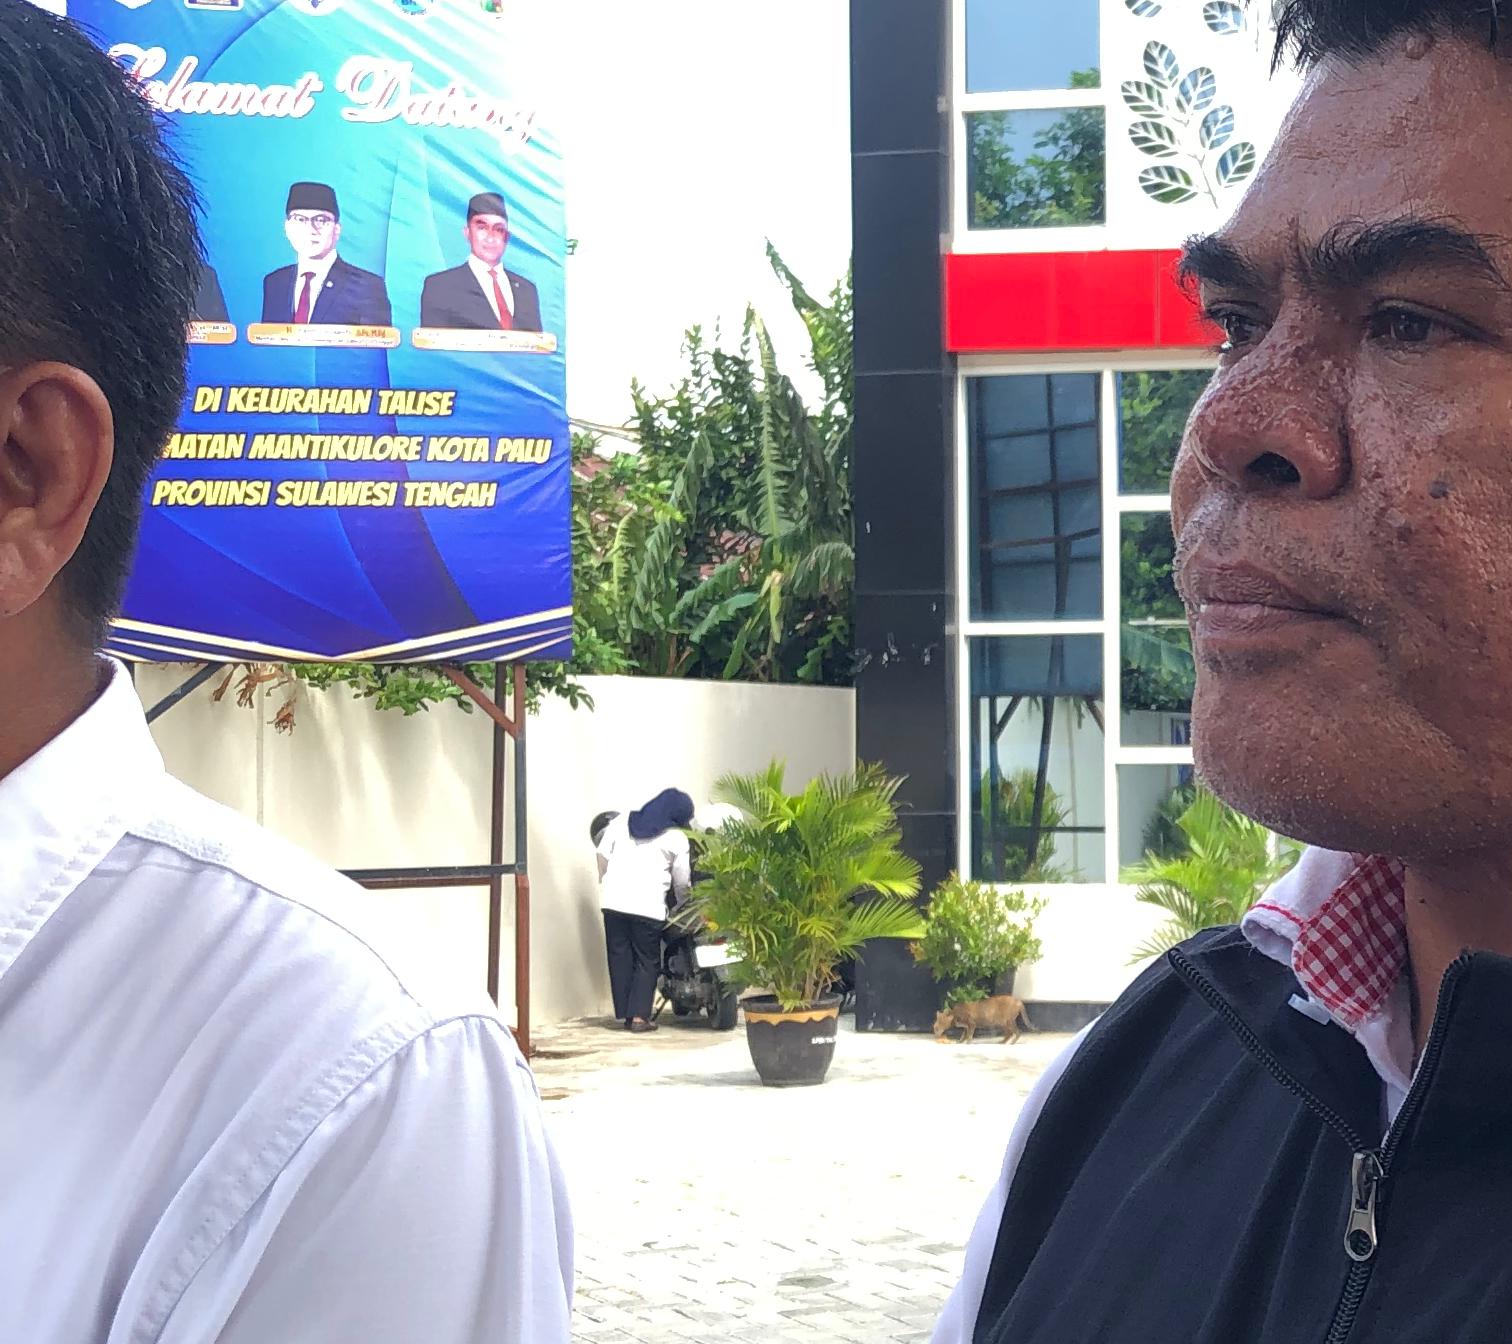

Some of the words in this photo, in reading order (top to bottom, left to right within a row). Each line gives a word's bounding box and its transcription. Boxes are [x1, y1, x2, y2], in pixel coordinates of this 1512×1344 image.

[335, 55, 543, 144] Datang
[193, 386, 224, 413] DI
[226, 387, 373, 415] KELURAHAN
[377, 389, 456, 416] TALISE
[163, 433, 246, 460] MATAN
[248, 433, 425, 462] MANTIKULORE
[426, 436, 490, 463] KOTA
[494, 437, 553, 465] PALU
[152, 479, 272, 507] PROVINSI
[275, 480, 398, 507] SULAWESI
[403, 481, 498, 508] TENGAH
